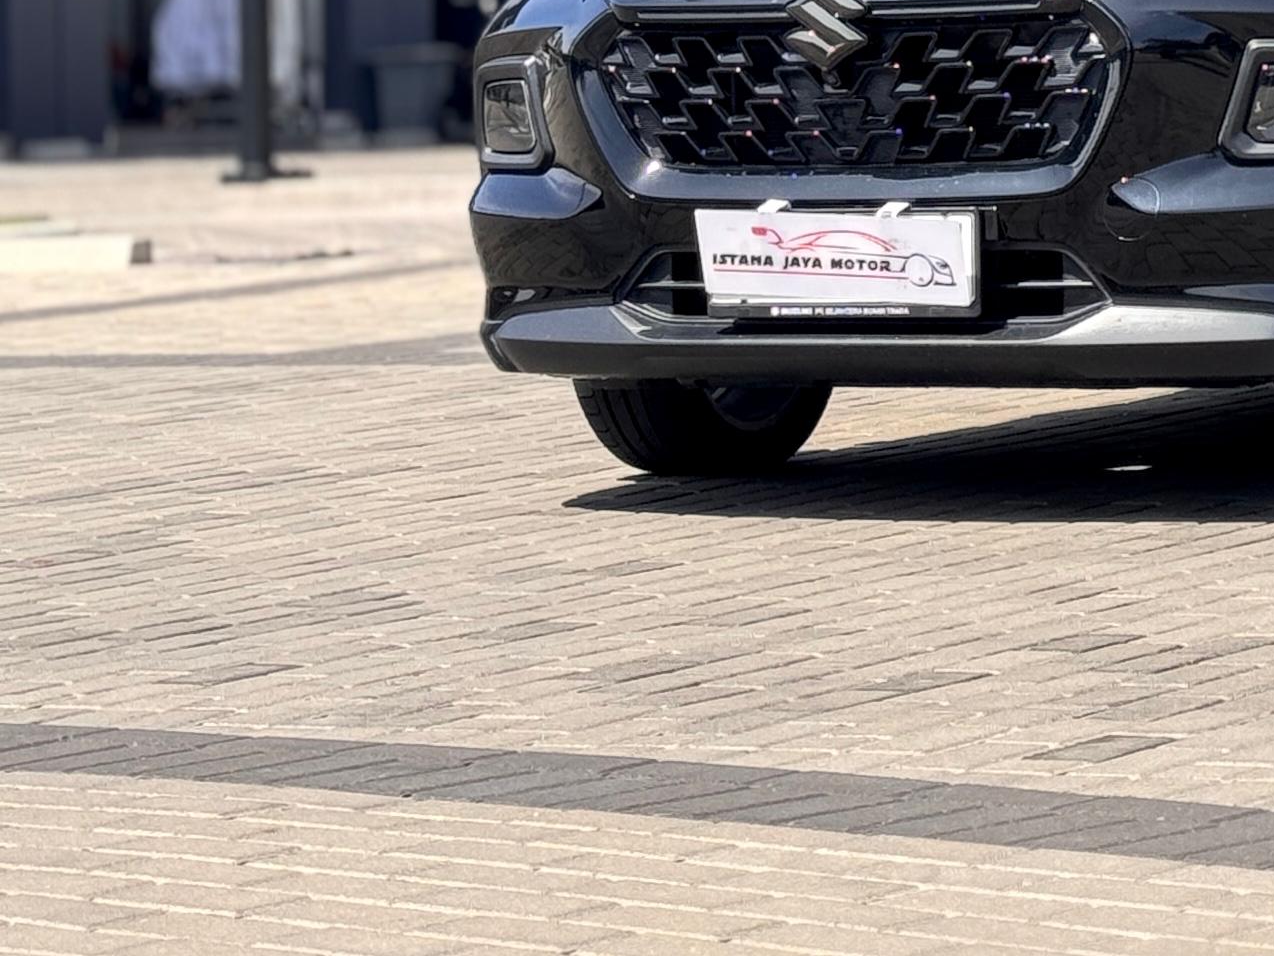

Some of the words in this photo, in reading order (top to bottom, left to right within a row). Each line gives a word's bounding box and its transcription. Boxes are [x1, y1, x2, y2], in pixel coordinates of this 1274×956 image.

[712, 253, 774, 267] ISTANA
[783, 256, 823, 270] JAYA
[831, 258, 892, 272] MOTOR
